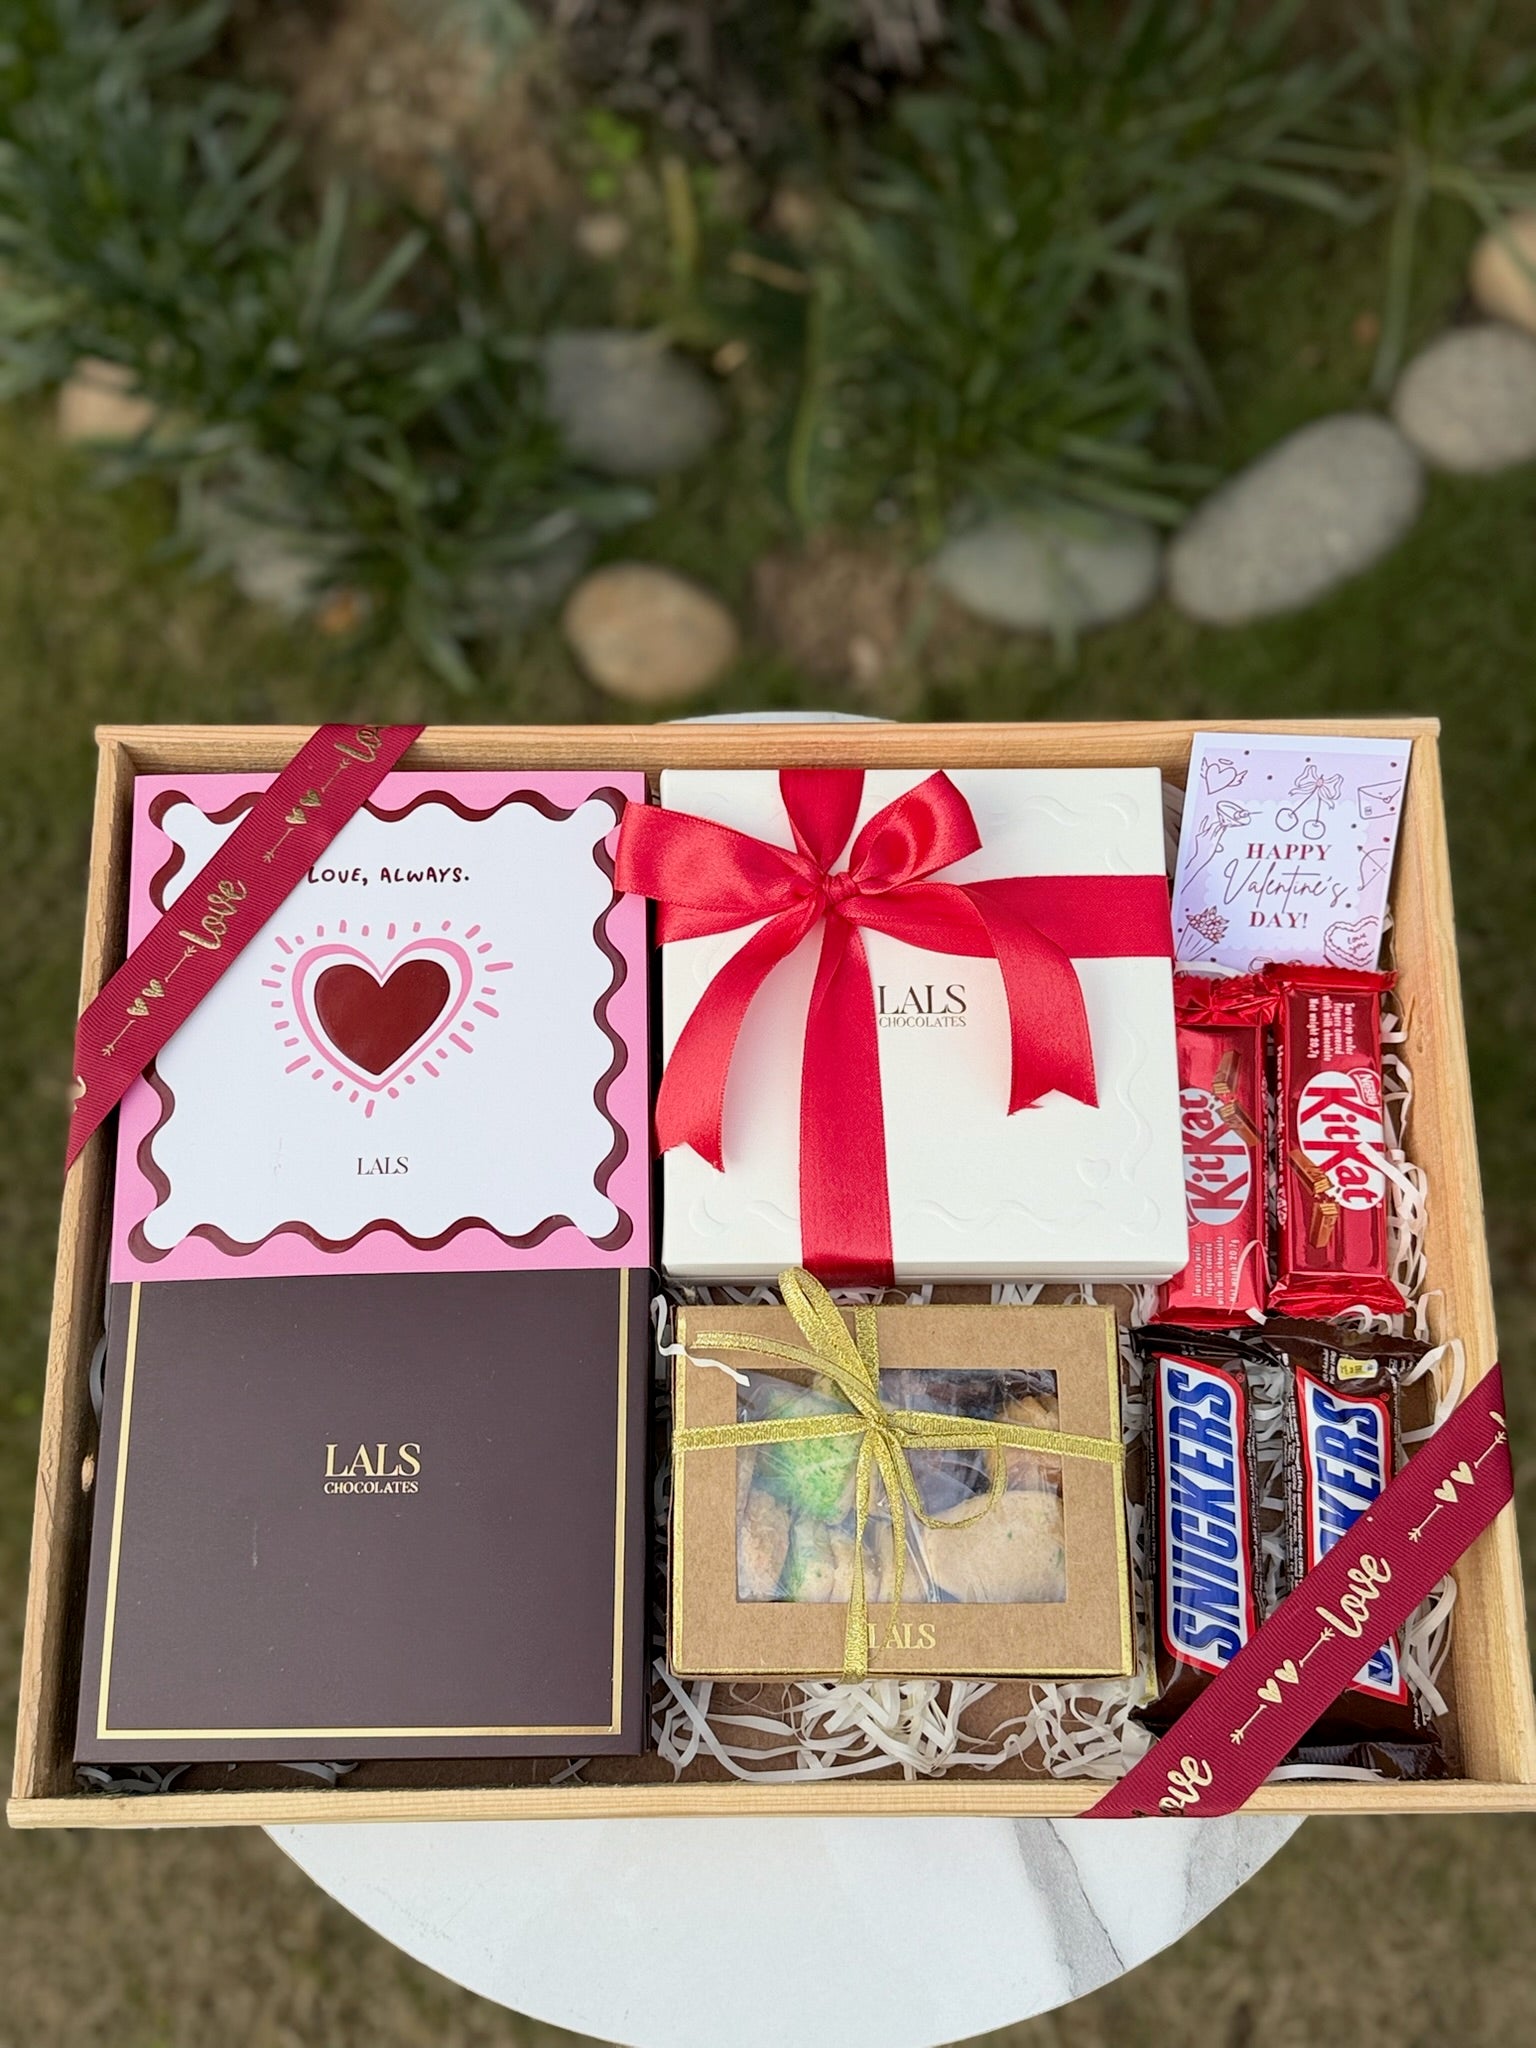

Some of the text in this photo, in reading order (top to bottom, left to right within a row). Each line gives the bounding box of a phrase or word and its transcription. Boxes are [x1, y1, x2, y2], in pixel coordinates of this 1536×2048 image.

[334, 726, 383, 763] lo
[1246, 842, 1332, 861] HAPPY
[307, 865, 470, 886] LOVE, ALWAYS.
[1223, 858, 1349, 914] Valentine's
[178, 879, 247, 950] love
[1248, 911, 1308, 929] DAY!
[877, 984, 967, 1015] LALS
[1308, 998, 1320, 1012] Net
[878, 1016, 967, 1028] CHOCOLATES
[1306, 1012, 1320, 1036] weight
[1322, 995, 1334, 1062] with milk chocolate
[1331, 1002, 1345, 1055] fingers covered
[1343, 1002, 1357, 1055] Two crisp wafer
[357, 1156, 409, 1176] LALS
[1203, 1242, 1216, 1296] fingers covered
[1215, 1236, 1224, 1270] chocolate
[1193, 1263, 1204, 1283] crisp
[324, 1442, 421, 1477] LALS
[323, 1481, 419, 1494] CHOCOLATES
[1166, 1366, 1242, 1663] SNICKERS
[1315, 1554, 1392, 1638] love
[866, 1622, 937, 1649] LALS
